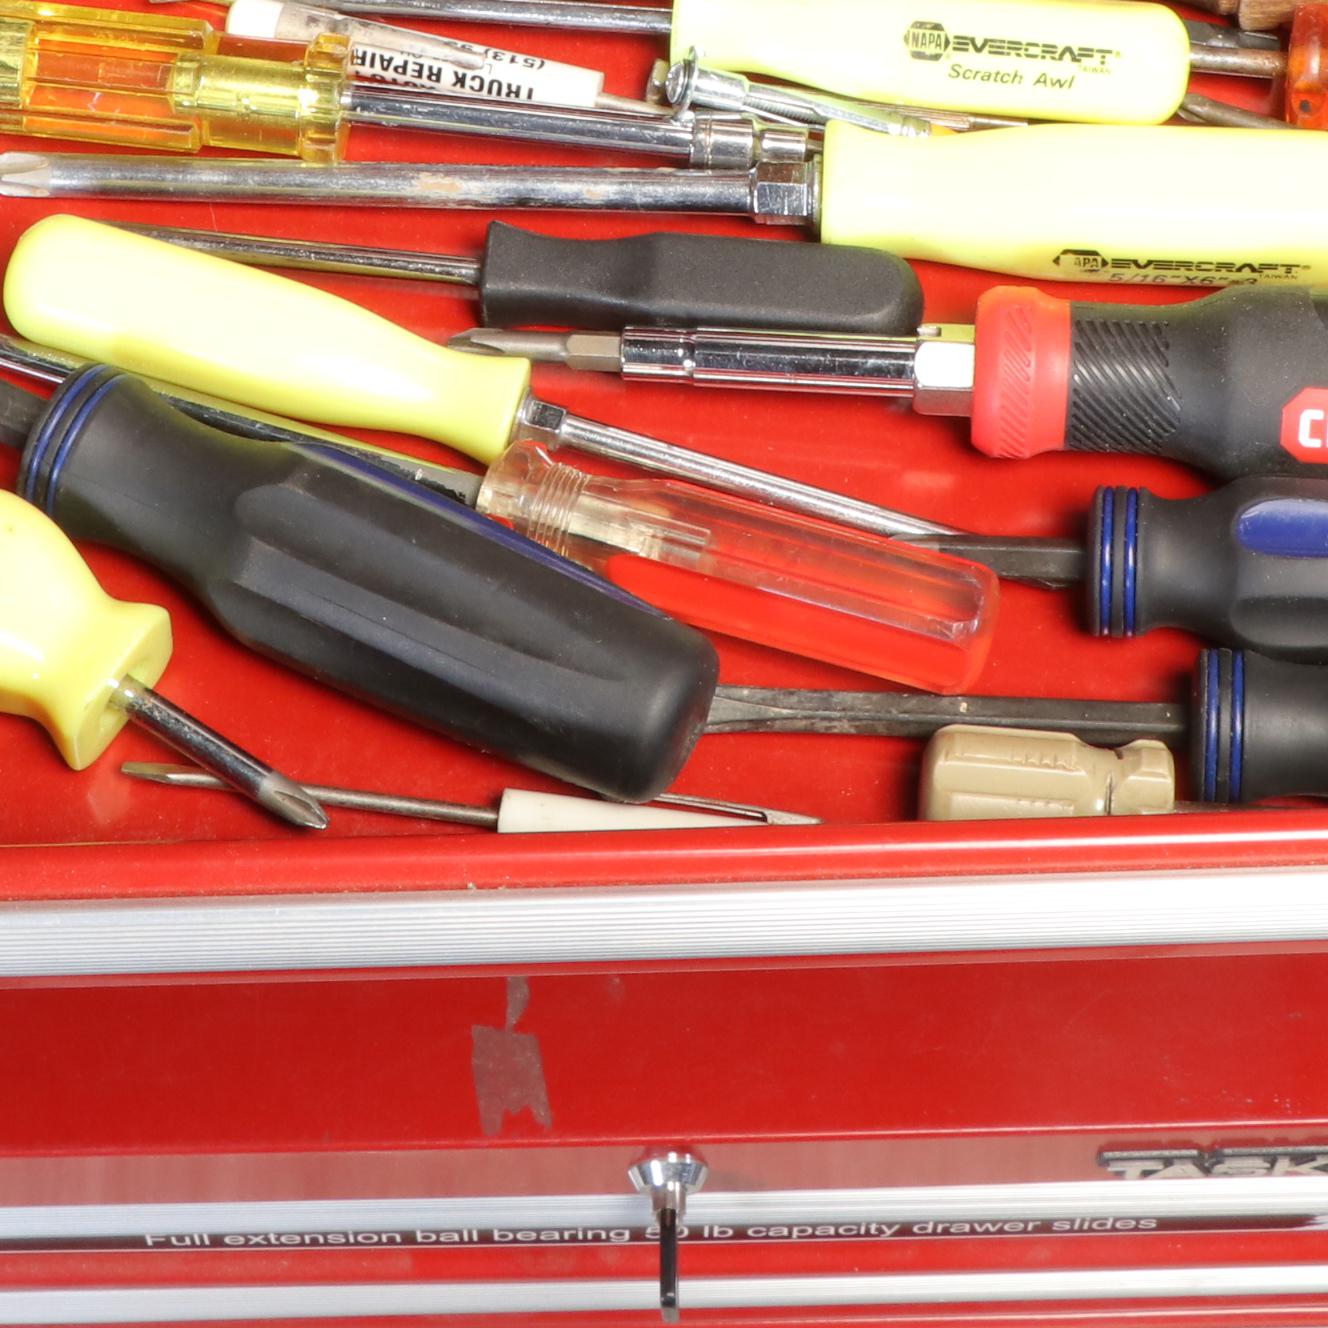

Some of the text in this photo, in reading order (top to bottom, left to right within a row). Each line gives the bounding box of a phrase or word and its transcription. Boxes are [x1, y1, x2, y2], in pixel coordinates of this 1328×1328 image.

[911, 32, 942, 49] NAPA
[351, 46, 442, 83] REPAIR
[484, 48, 545, 70] (513)
[948, 63, 1076, 89] Scratch Awl
[145, 1232, 210, 1247] Full
[223, 1229, 402, 1245] extension
[416, 1227, 478, 1244] ball
[492, 1225, 631, 1244] bearing
[703, 1223, 733, 1239] lb
[748, 1219, 901, 1239] capacity
[912, 1216, 1041, 1233] drawer
[1051, 1215, 1158, 1231] slides
